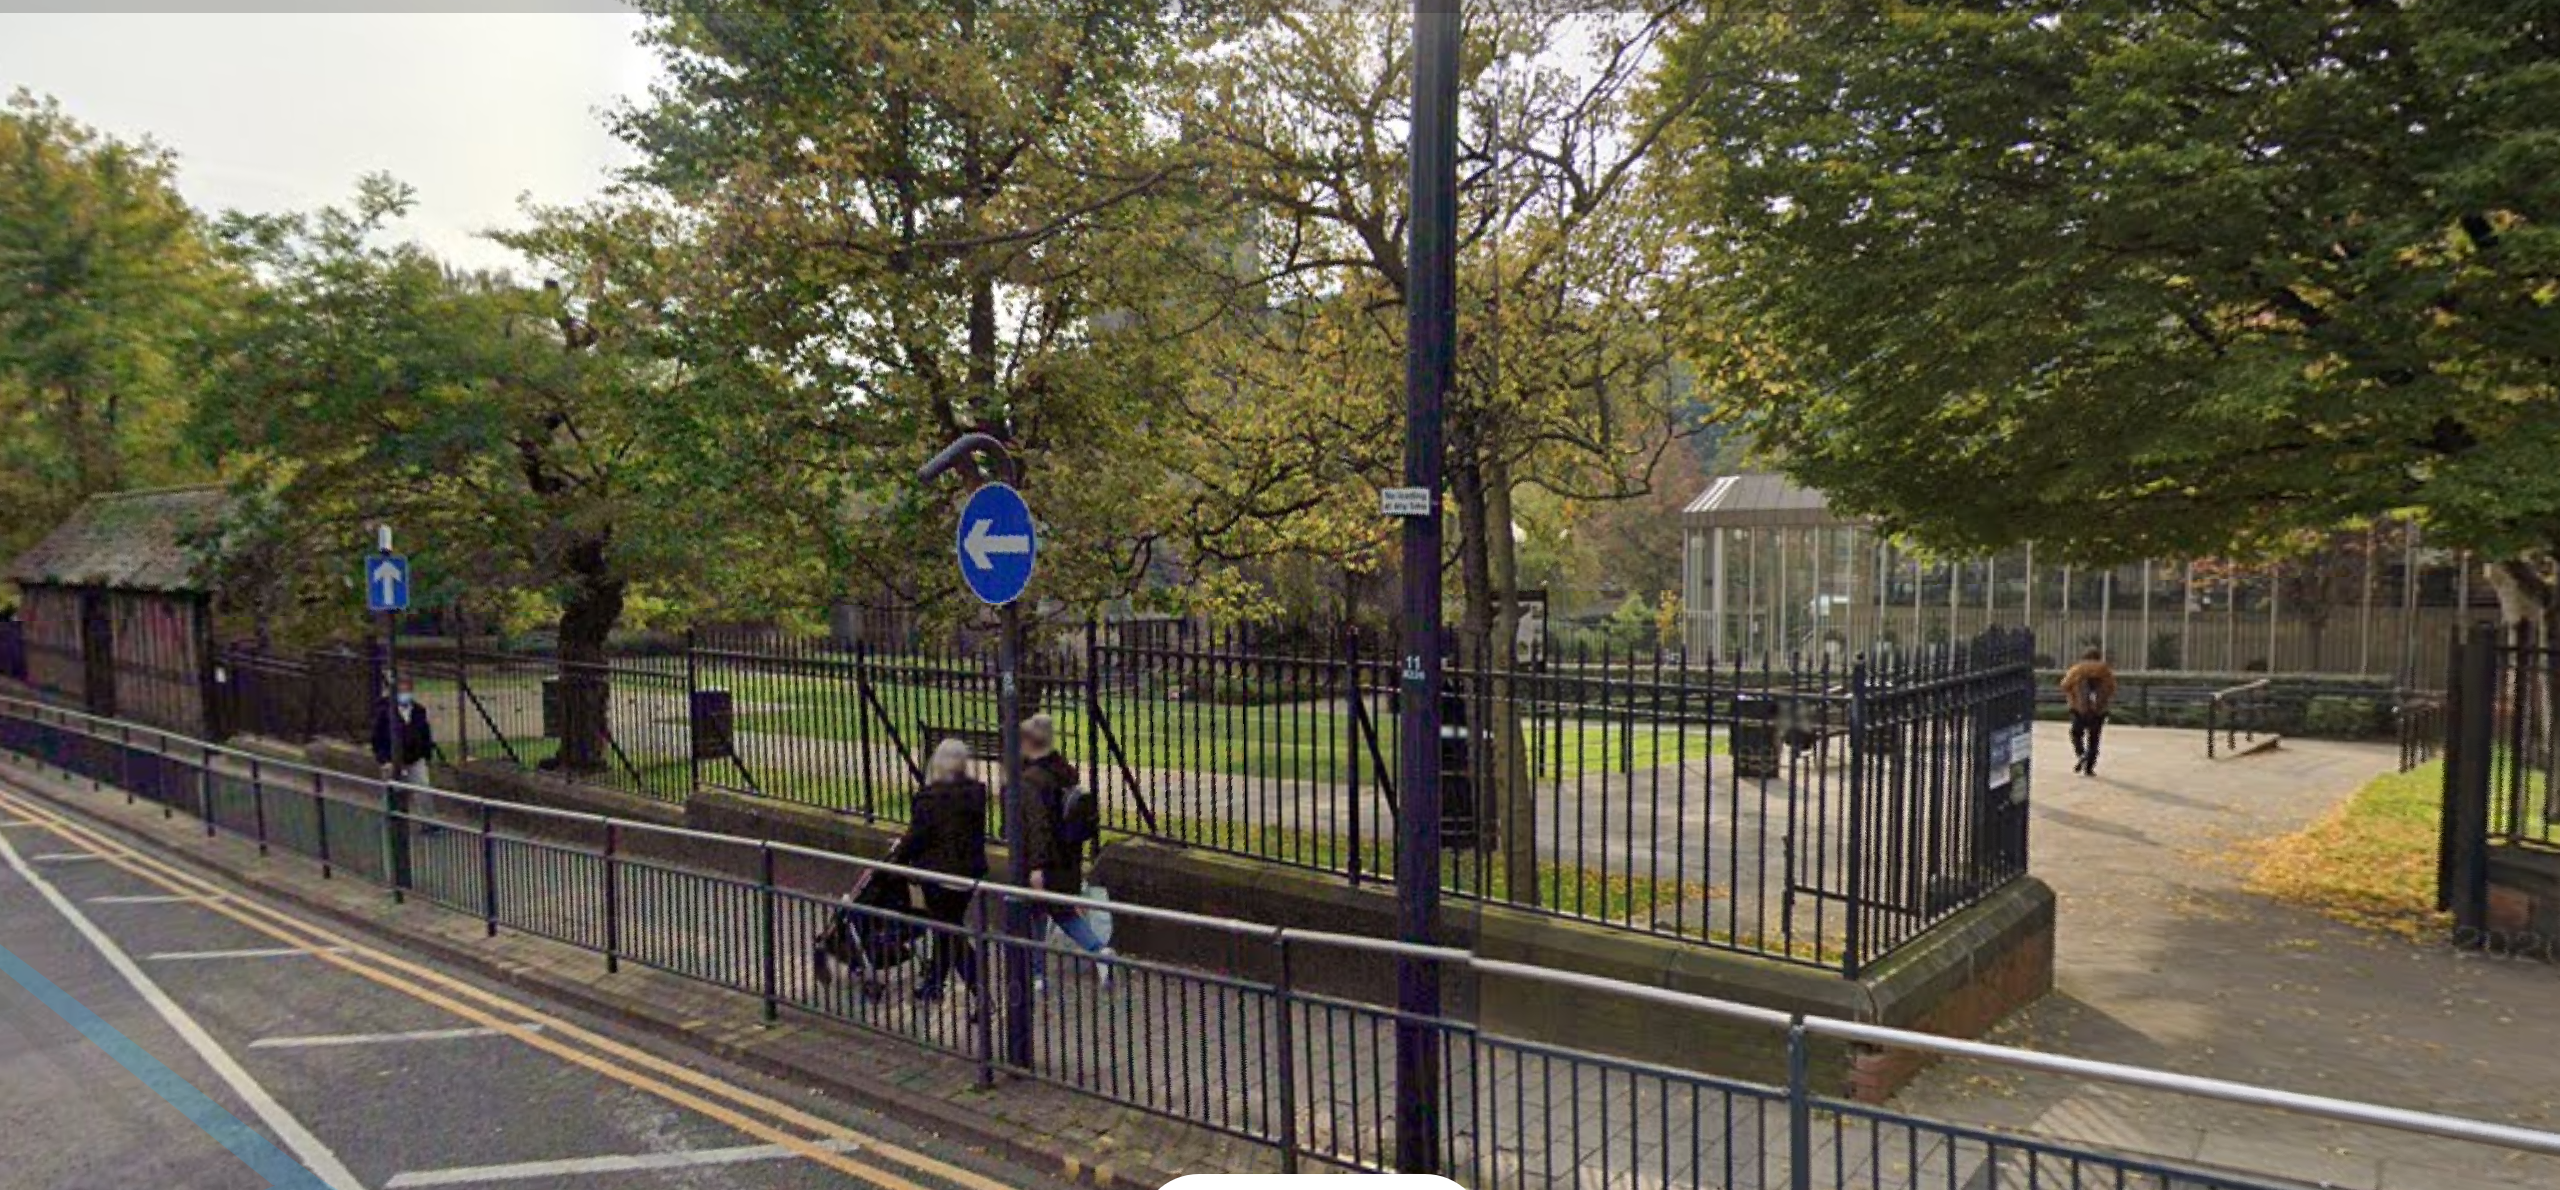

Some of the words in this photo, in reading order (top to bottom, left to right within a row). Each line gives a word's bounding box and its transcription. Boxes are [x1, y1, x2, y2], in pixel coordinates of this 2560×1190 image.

[1384, 491, 1395, 500] No
[1397, 491, 1427, 501] loading
[1393, 502, 1407, 511] any
[1406, 655, 1420, 669] 11
